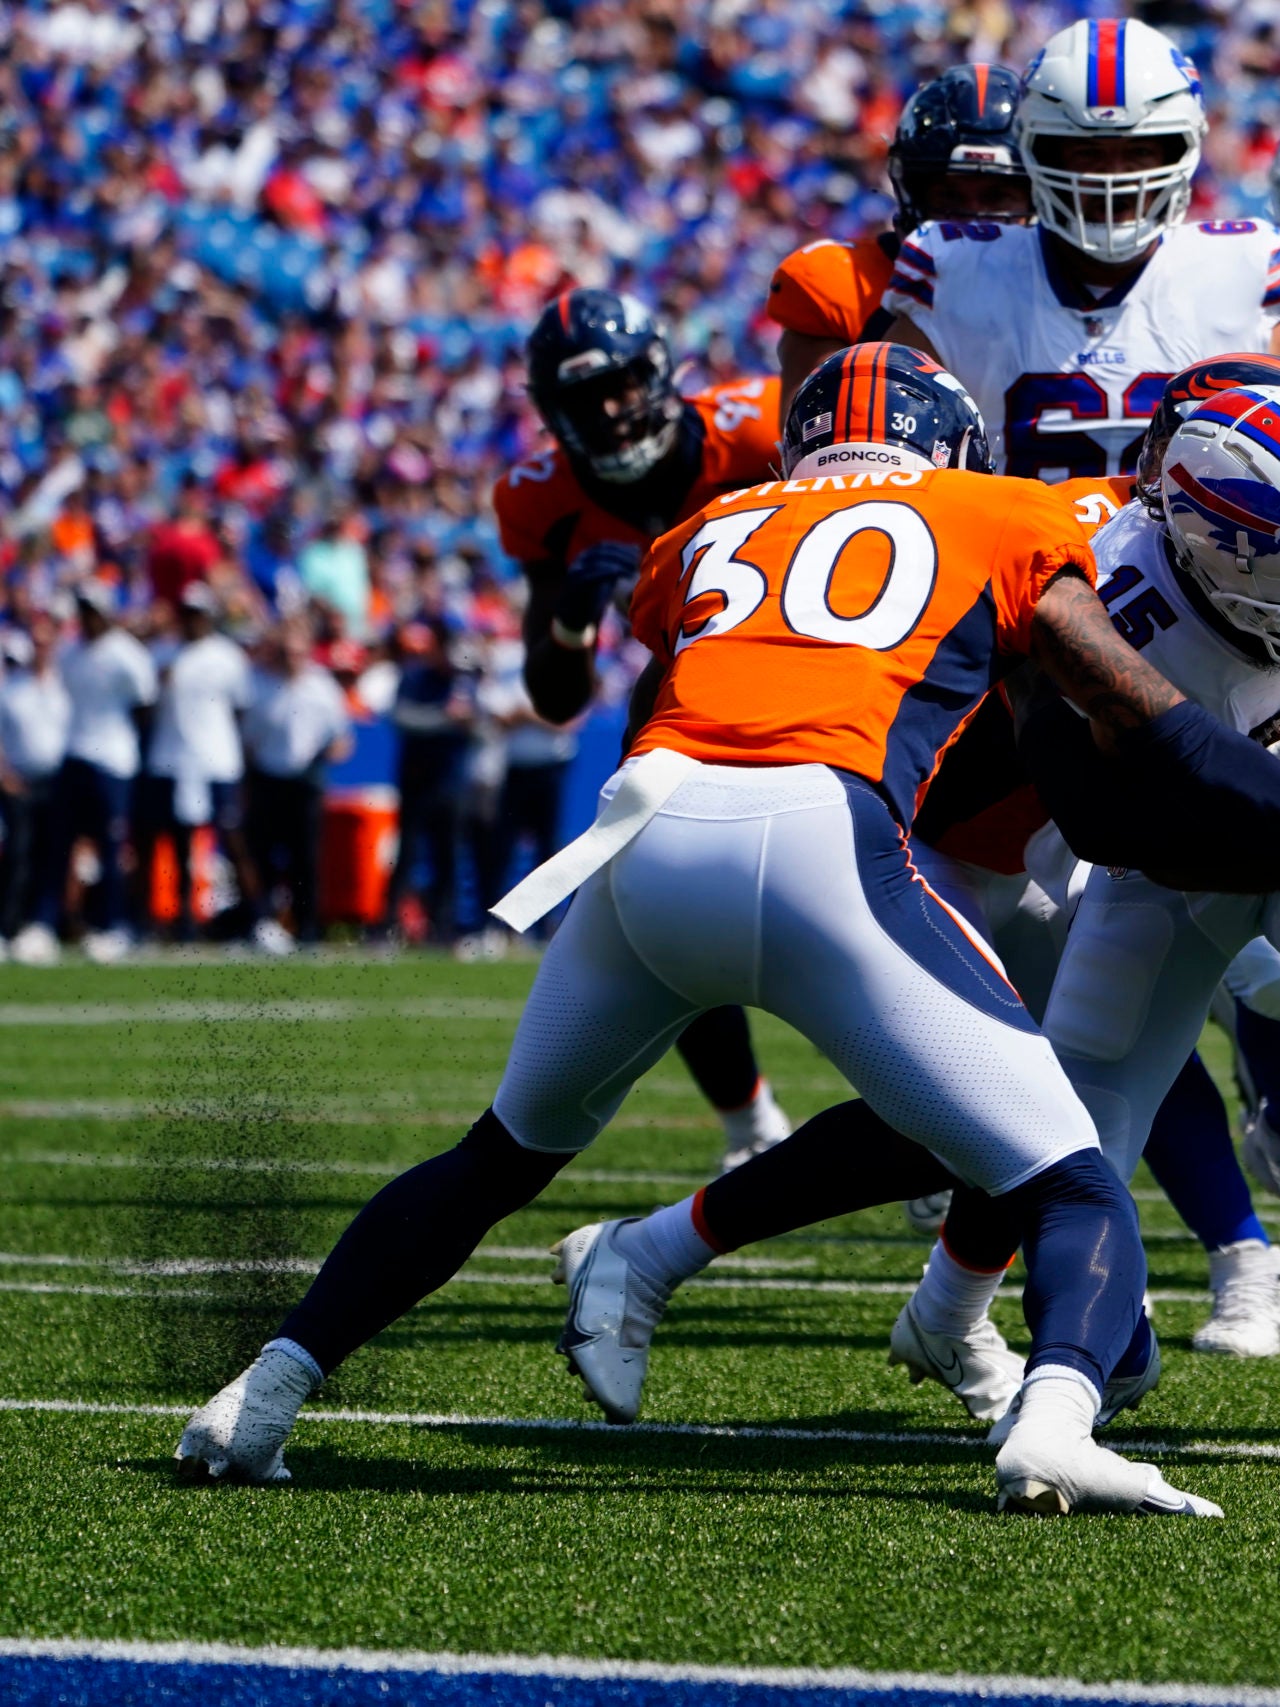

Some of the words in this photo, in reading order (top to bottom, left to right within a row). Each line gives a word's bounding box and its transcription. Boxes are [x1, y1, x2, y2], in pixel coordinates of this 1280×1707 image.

[891, 412, 917, 434] 30
[817, 451, 902, 467] BRONCOS
[672, 499, 939, 653] 30
[1097, 565, 1179, 652] 15
